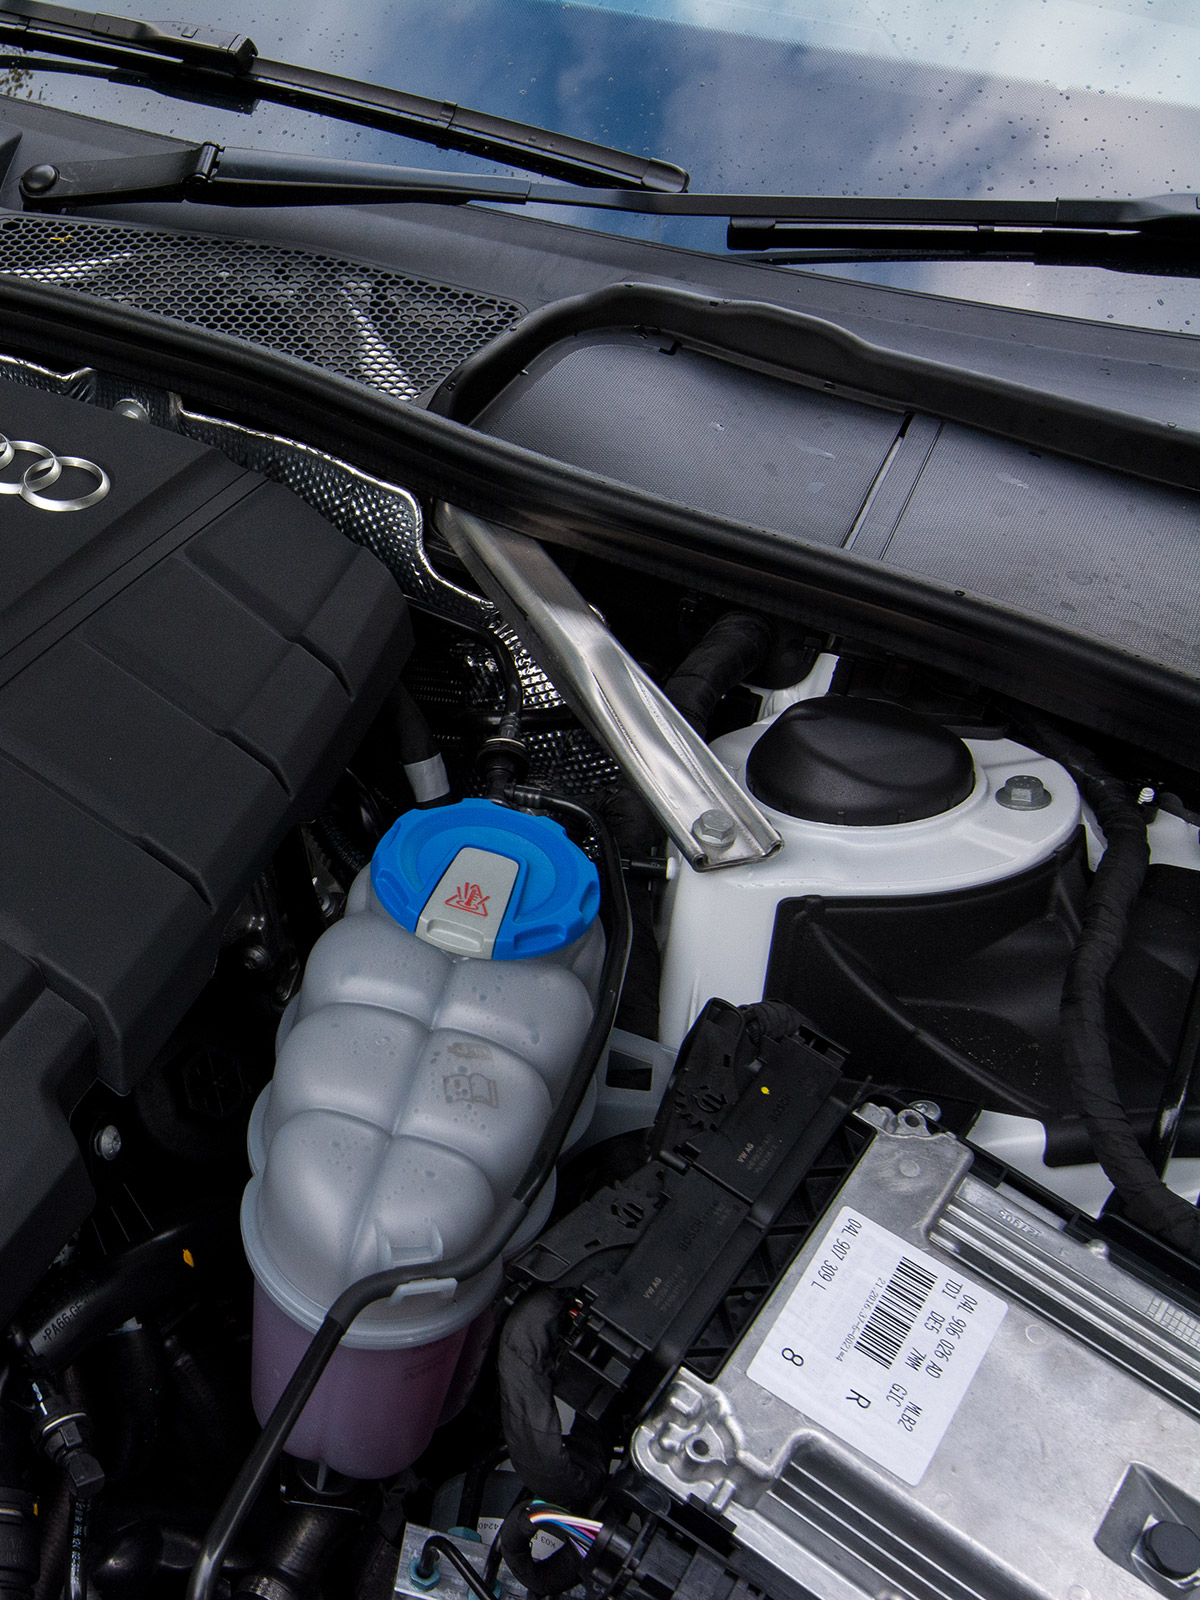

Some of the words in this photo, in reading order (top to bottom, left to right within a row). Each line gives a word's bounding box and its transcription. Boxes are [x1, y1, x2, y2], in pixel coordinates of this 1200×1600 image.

[841, 1218, 863, 1238] 04L
[831, 1238, 851, 1261] 907
[817, 1259, 839, 1282] 309
[810, 1280, 827, 1291] L
[956, 1294, 978, 1314] 04L
[923, 1310, 946, 1334] DE5
[945, 1315, 967, 1339] 906
[780, 1347, 805, 1367] 8
[904, 1347, 927, 1372] 7MM
[933, 1338, 955, 1362] 026
[925, 1360, 943, 1379] AD
[846, 1388, 872, 1409] R
[897, 1401, 923, 1432] MLB2
